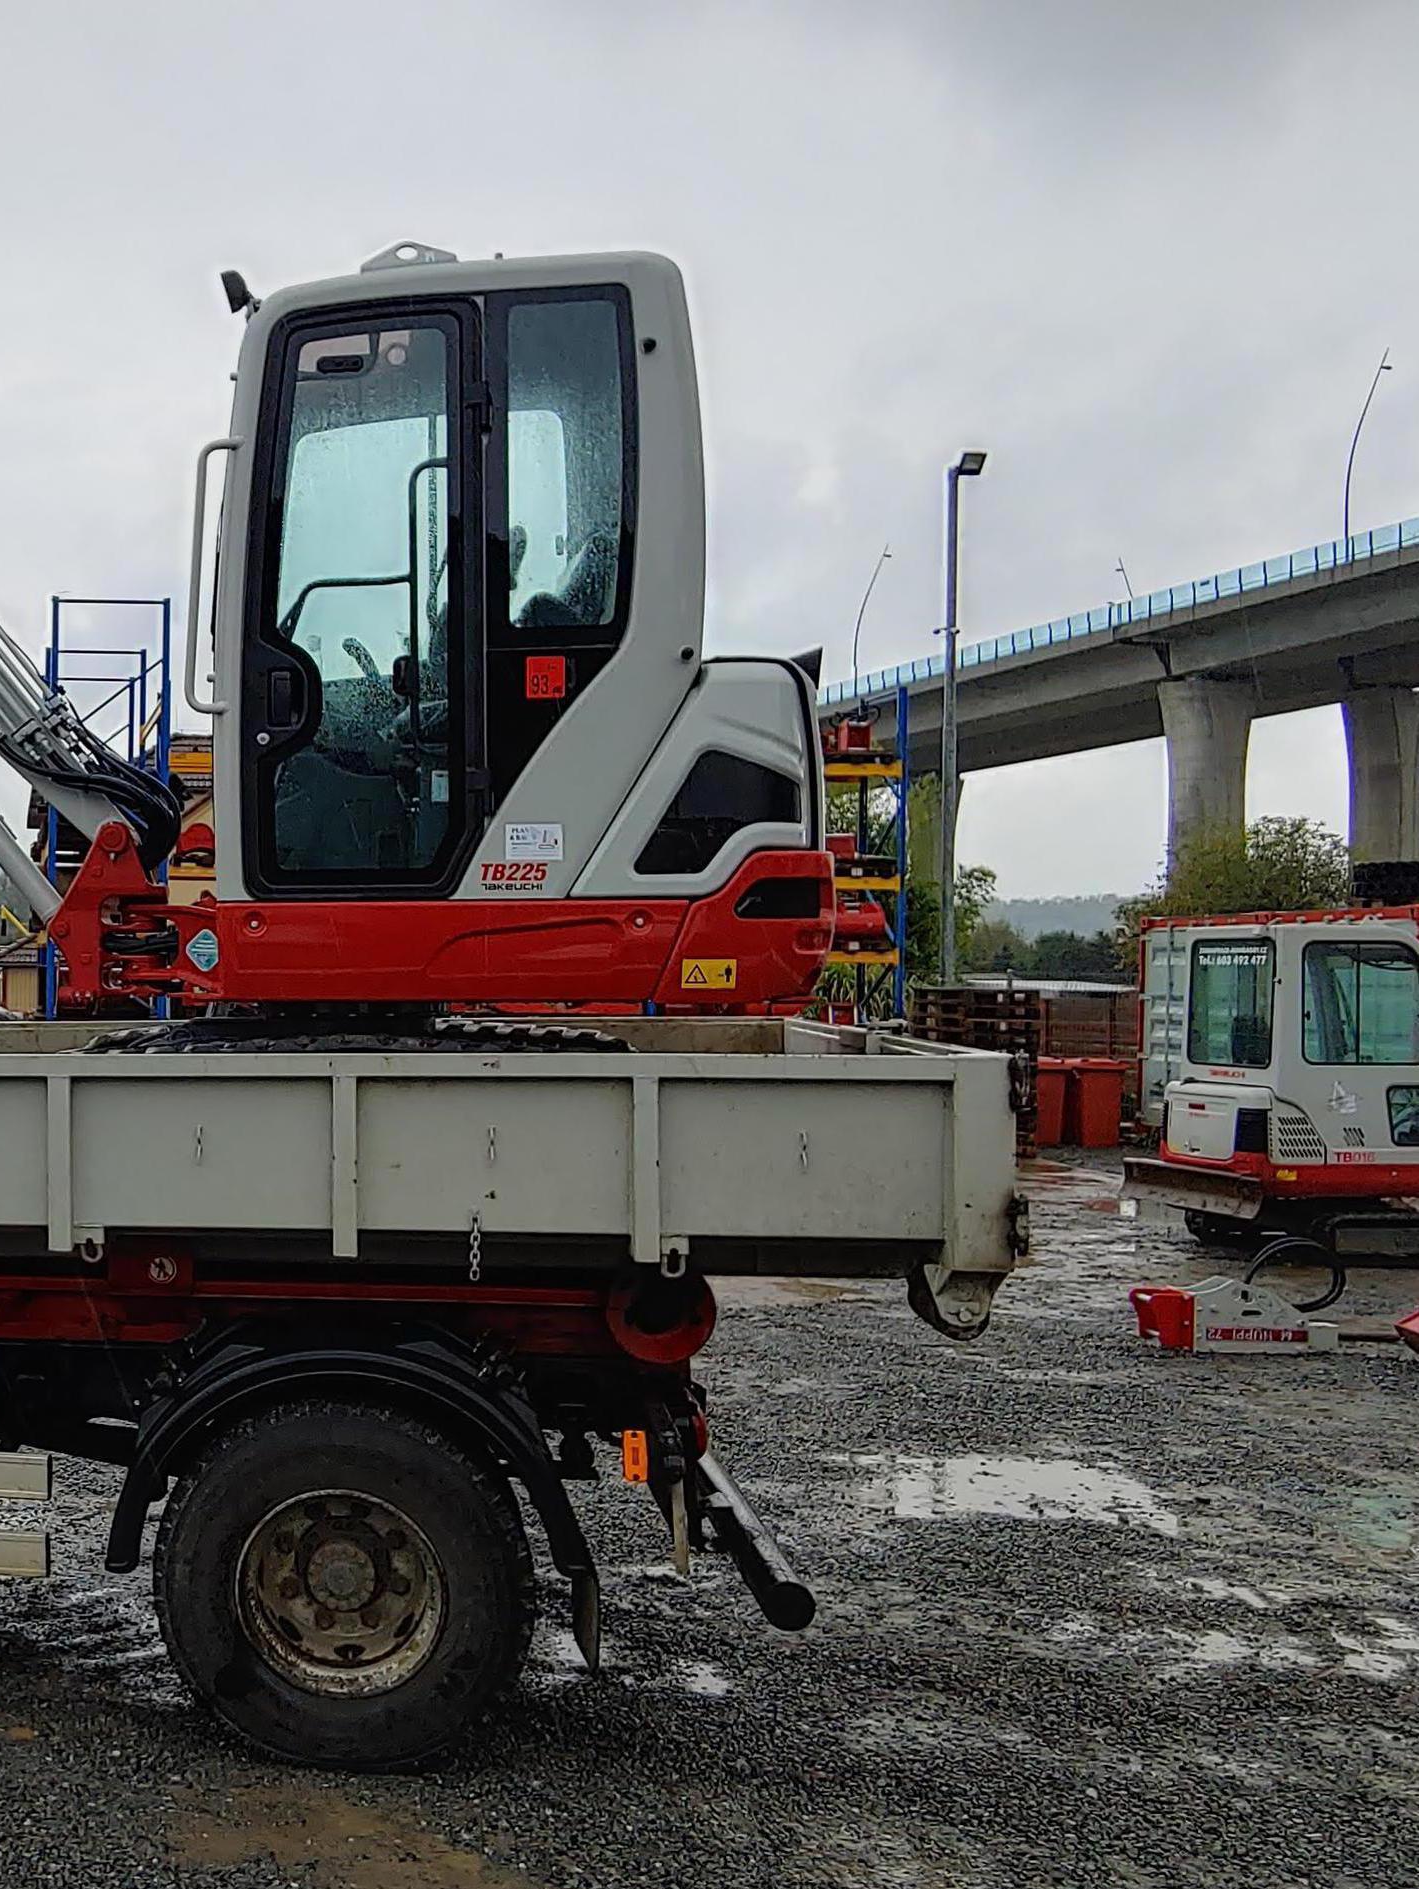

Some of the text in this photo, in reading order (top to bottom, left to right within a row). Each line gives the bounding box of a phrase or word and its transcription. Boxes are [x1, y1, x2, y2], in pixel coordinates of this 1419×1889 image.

[531, 674, 549, 696] 93
[481, 863, 548, 881] TB225
[481, 883, 543, 891] TAKEUCHI
[1216, 955, 1231, 966] 603
[1233, 955, 1249, 966] 492
[1250, 955, 1267, 966] 477
